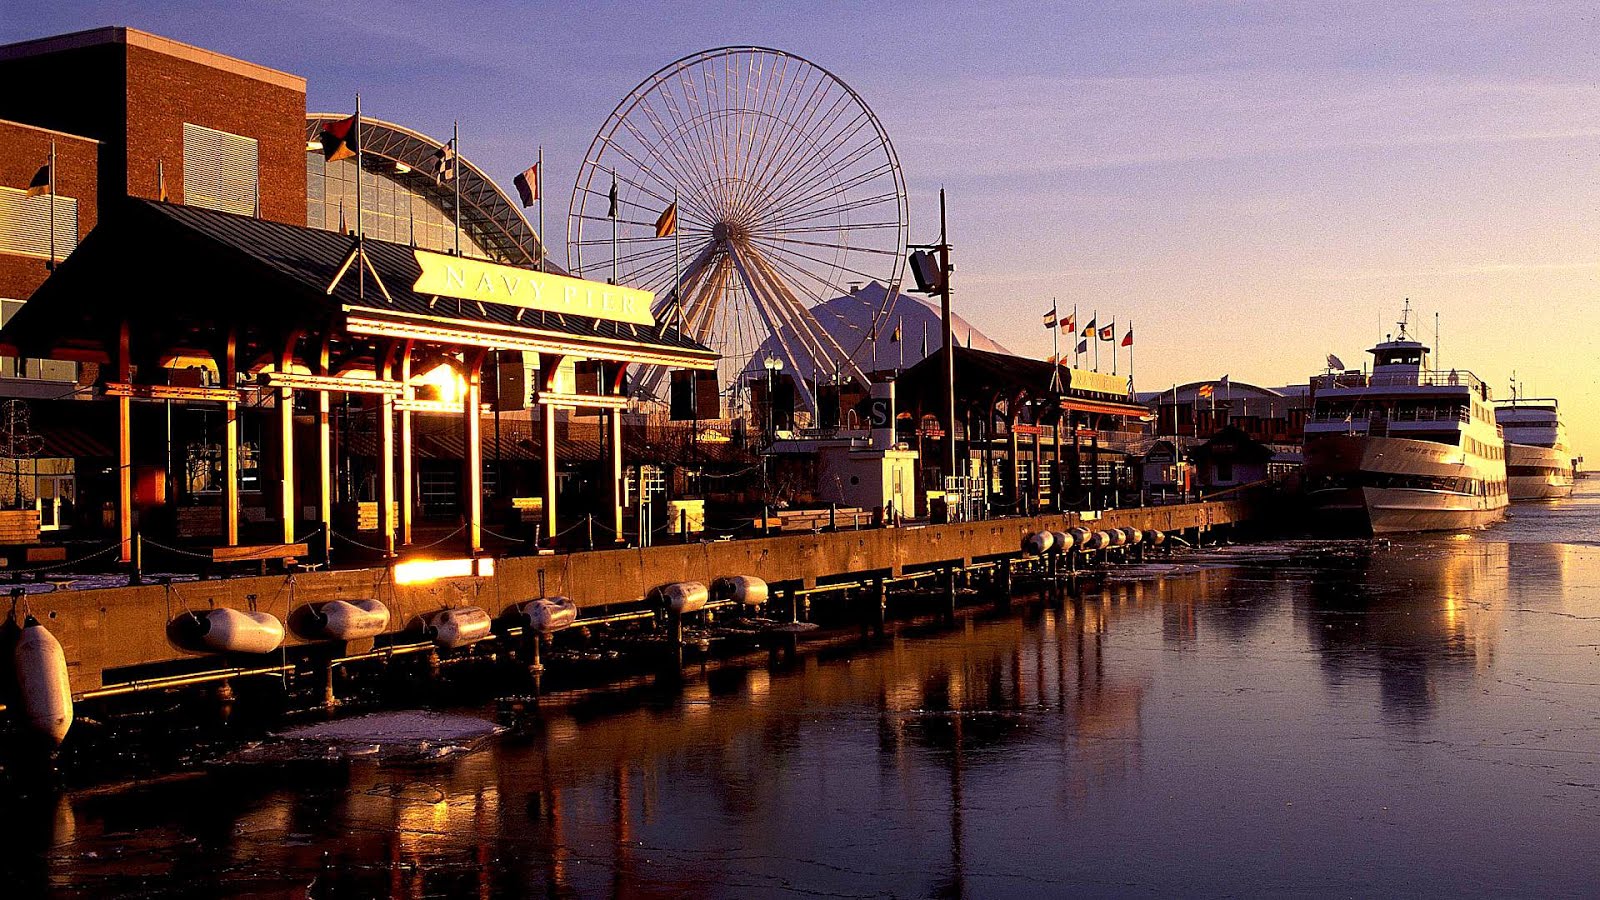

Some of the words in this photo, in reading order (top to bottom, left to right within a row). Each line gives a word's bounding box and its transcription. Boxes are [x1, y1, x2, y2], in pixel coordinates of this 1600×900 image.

[445, 265, 545, 301] NAVY
[563, 285, 638, 315] PIER
[872, 401, 887, 426] S
